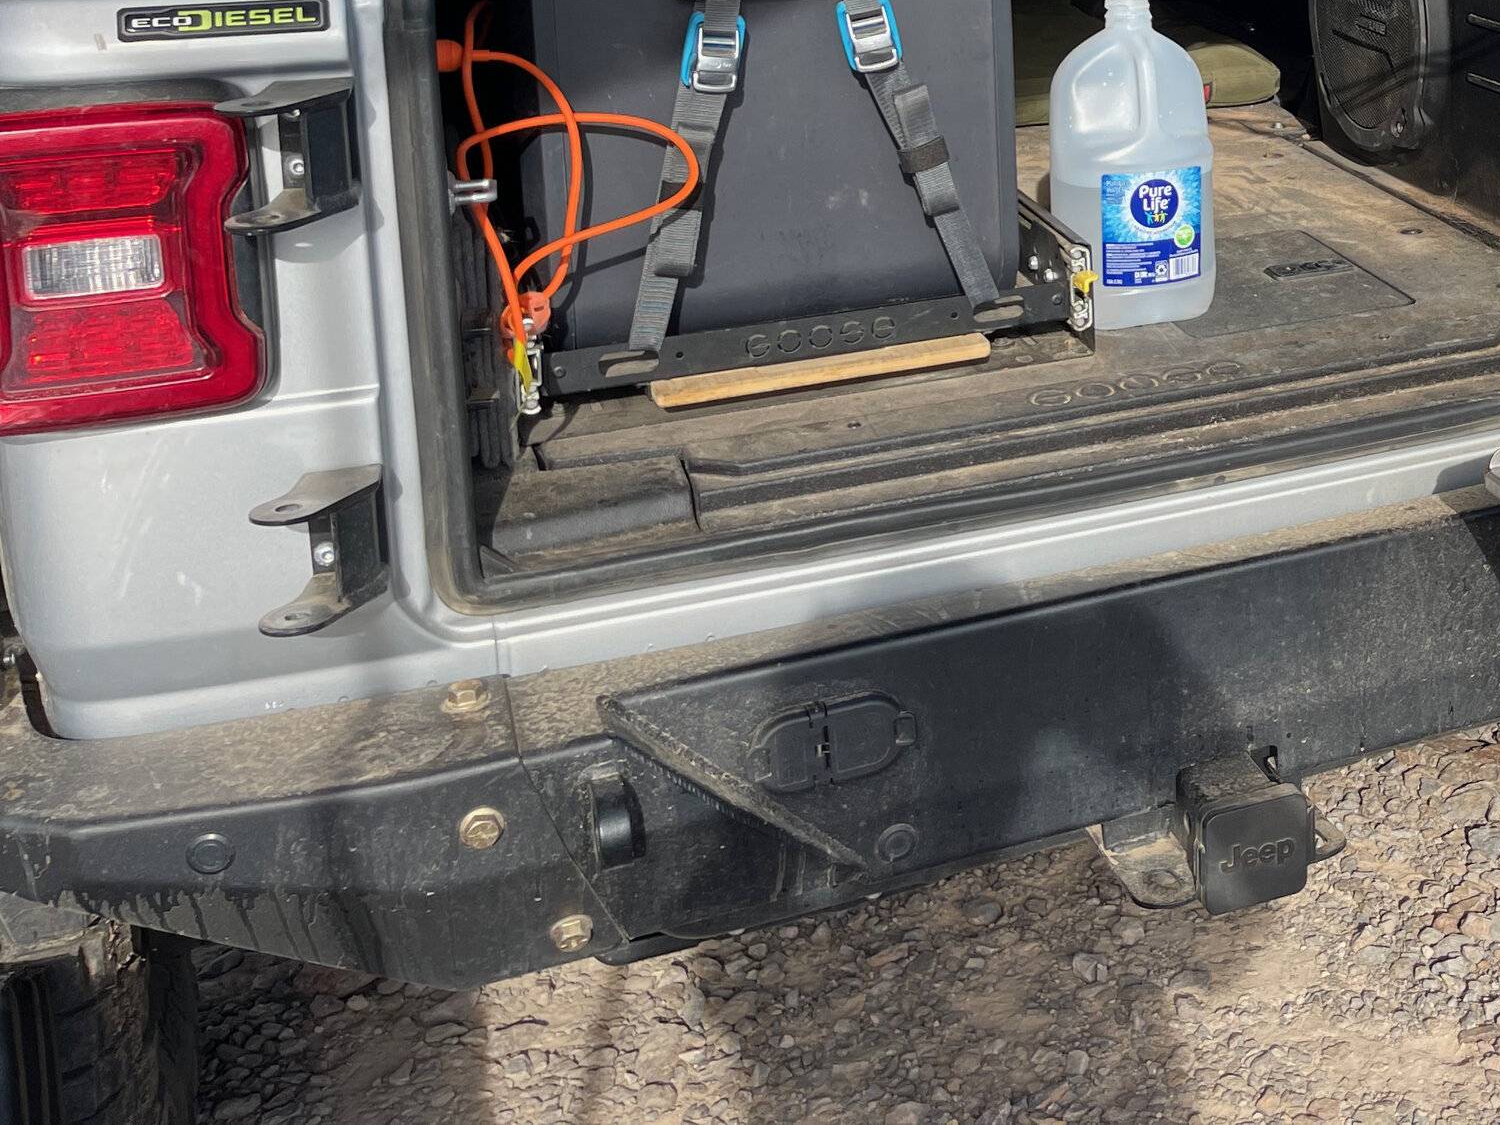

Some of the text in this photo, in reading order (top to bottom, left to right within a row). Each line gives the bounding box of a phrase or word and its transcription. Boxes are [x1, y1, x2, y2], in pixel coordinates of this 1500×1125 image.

[1138, 185, 1172, 199] Pure
[1143, 197, 1170, 213] Life
[1219, 837, 1295, 873] Jeep
